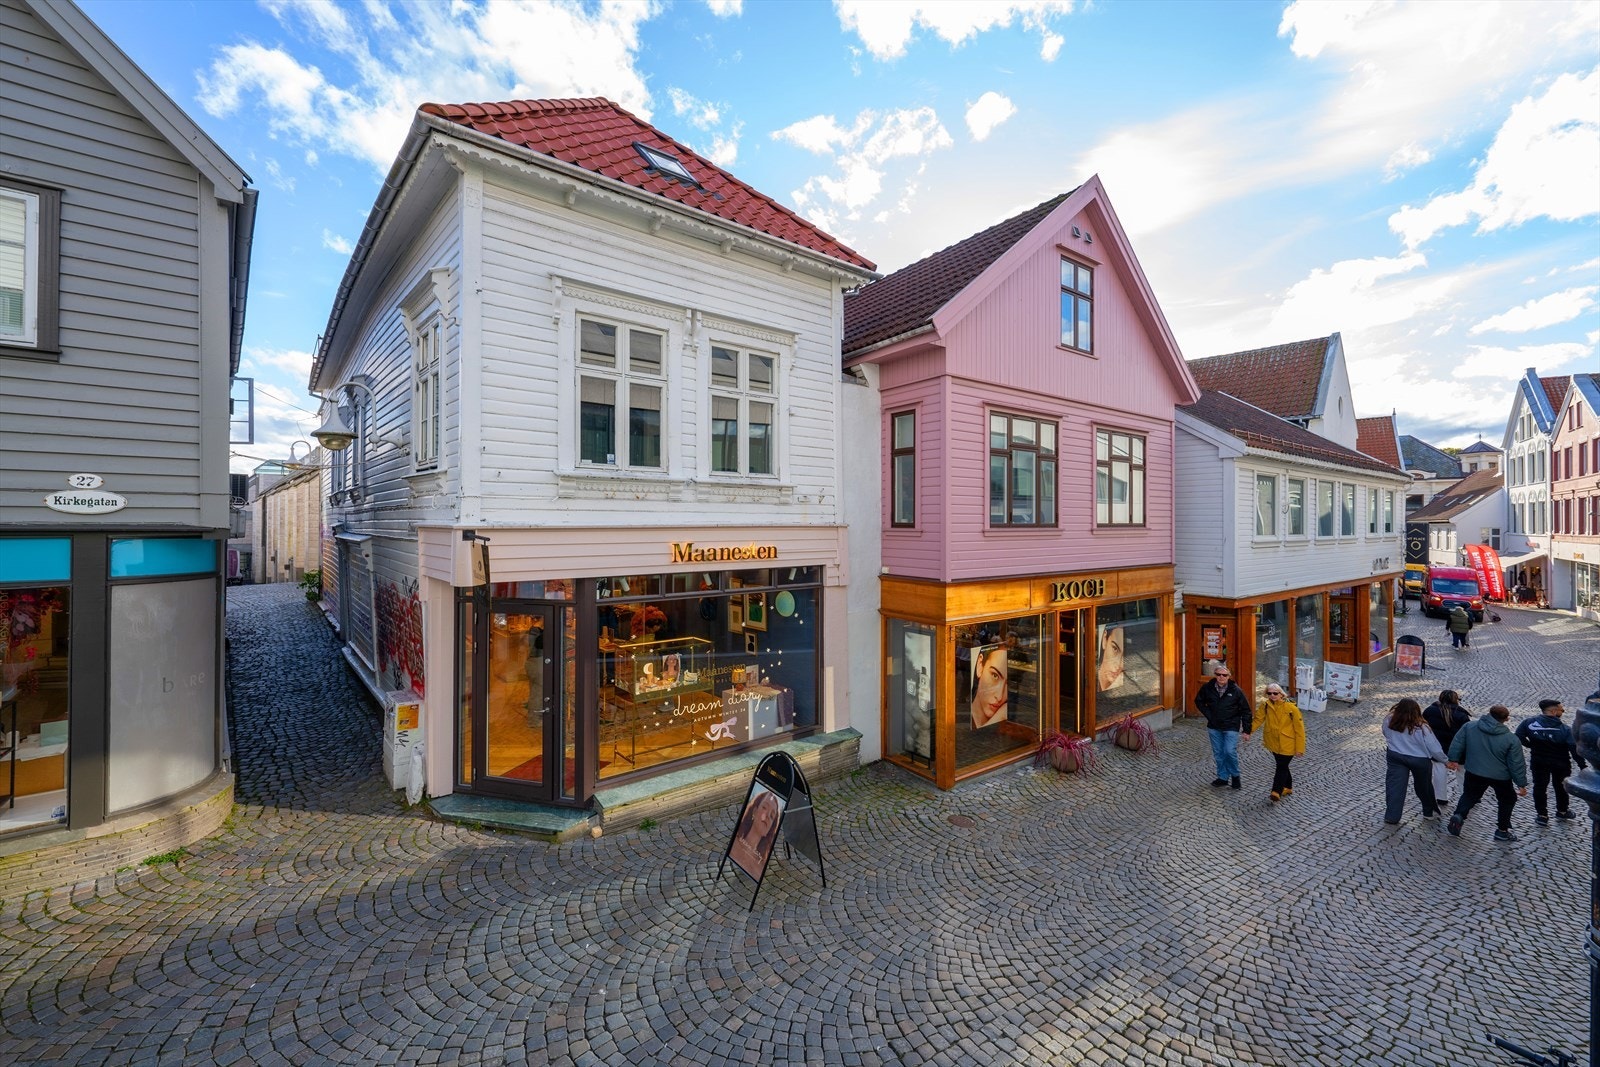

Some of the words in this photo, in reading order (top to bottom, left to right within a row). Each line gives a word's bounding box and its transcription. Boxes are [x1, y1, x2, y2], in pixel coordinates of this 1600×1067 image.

[76, 475, 95, 487] 27
[53, 495, 118, 508] Kirkegaten
[671, 541, 778, 563] Maanesten
[1053, 578, 1106, 602] KOCH
[697, 664, 746, 678] Maanesten
[673, 694, 724, 717] dream
[728, 685, 763, 713] diary
[693, 714, 716, 723] AUTUMN
[718, 709, 738, 717] WINTER
